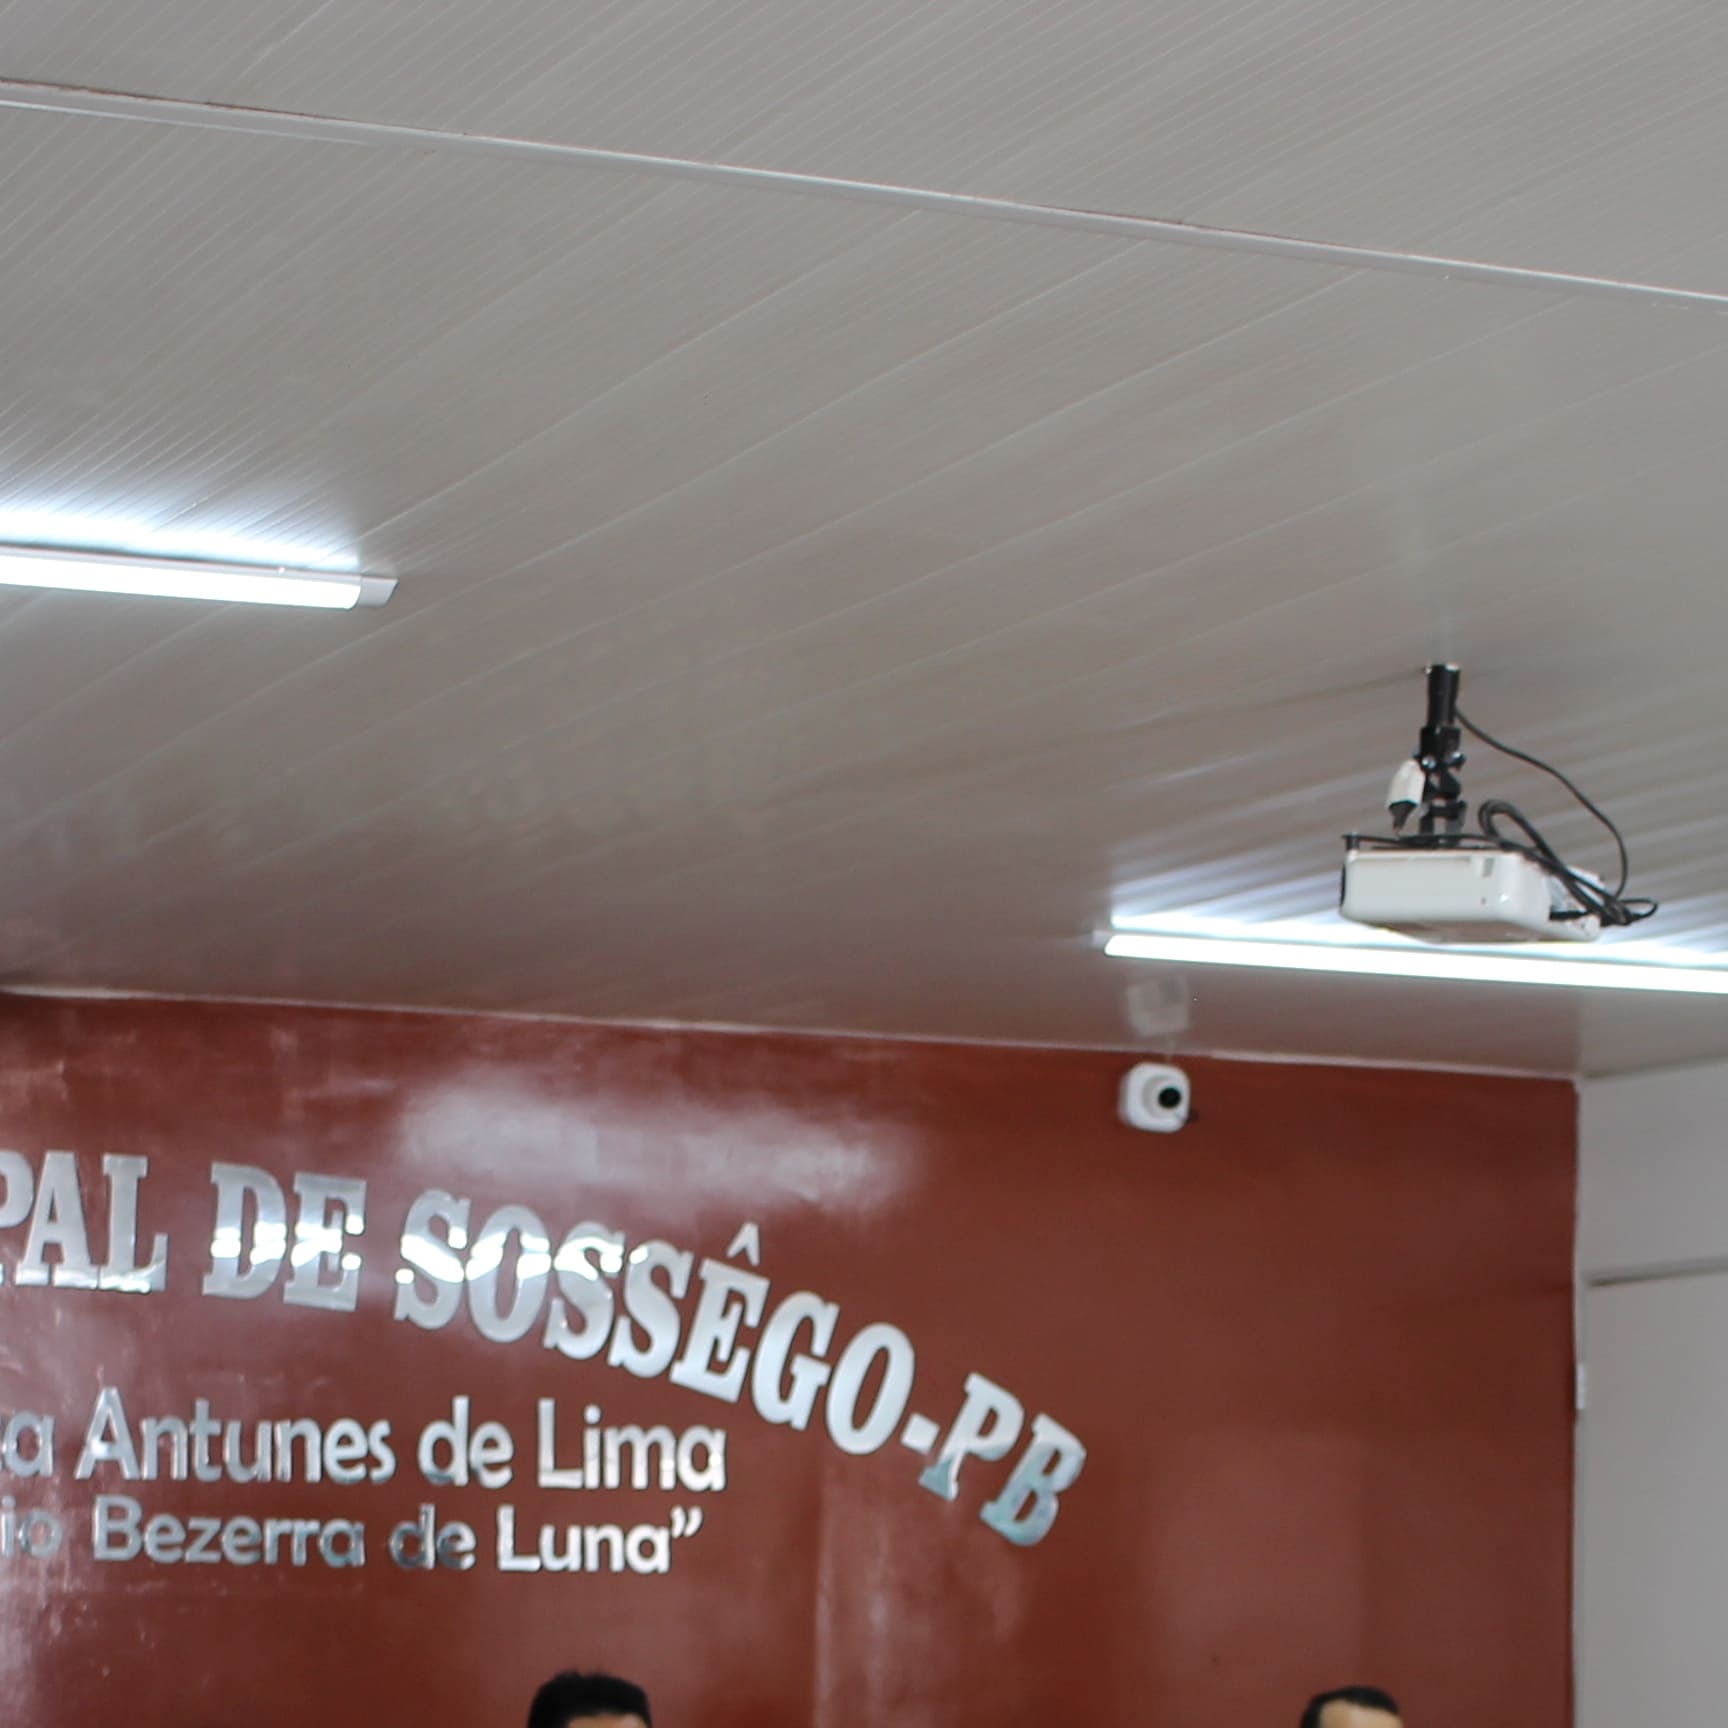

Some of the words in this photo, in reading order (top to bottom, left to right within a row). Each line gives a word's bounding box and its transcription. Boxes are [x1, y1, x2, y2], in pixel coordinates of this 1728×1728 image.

[201, 1161, 367, 1312] DE
[75, 1386, 397, 1484] Antunes
[417, 1395, 515, 1490] de
[536, 1397, 727, 1492] Lima
[92, 1495, 366, 1568] Bezerra
[388, 1502, 477, 1572] de
